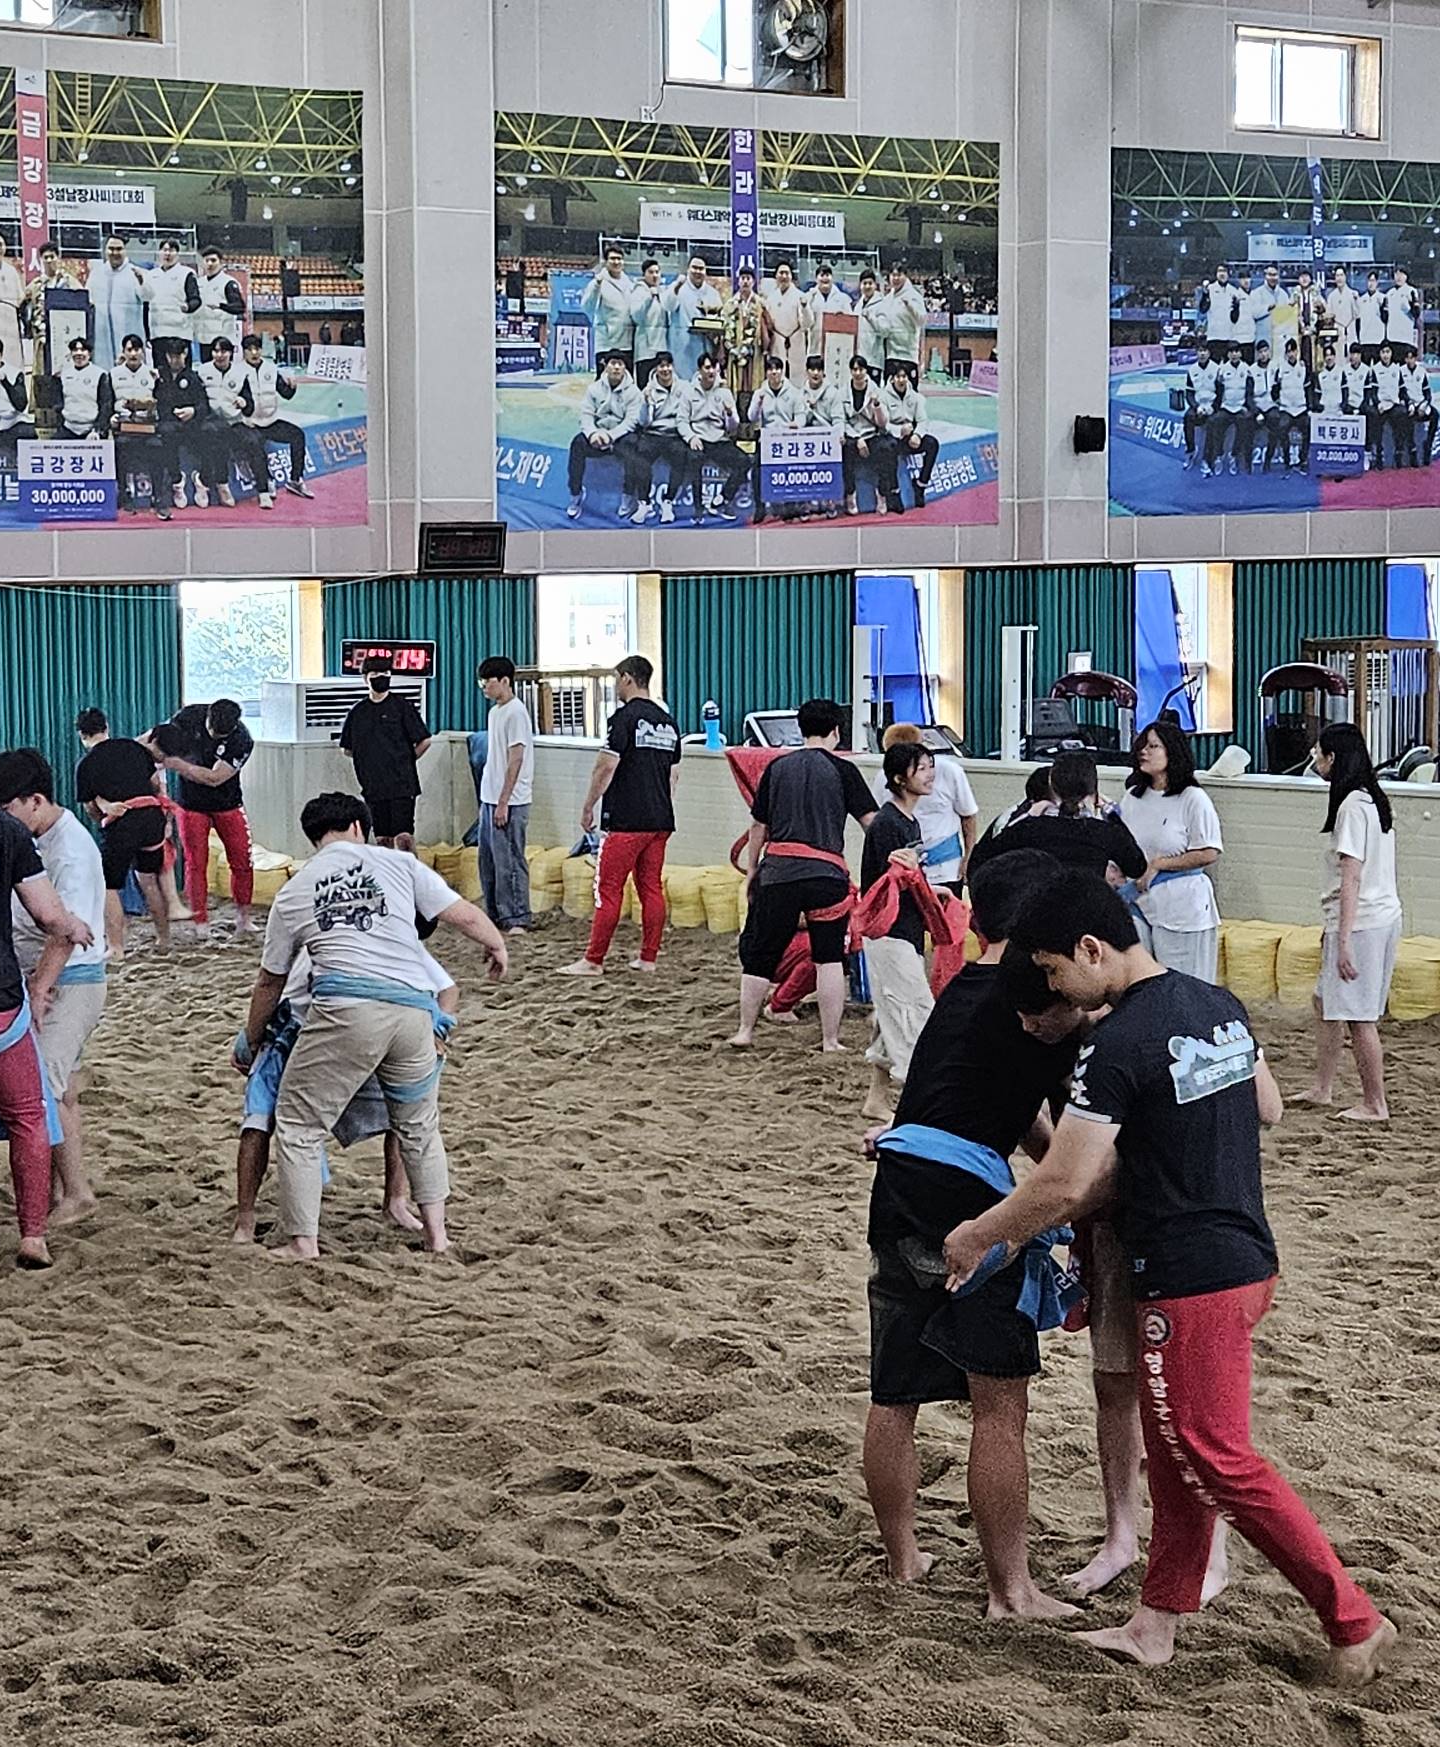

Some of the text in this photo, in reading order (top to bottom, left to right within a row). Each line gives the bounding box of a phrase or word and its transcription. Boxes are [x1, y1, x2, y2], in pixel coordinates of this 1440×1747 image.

[1143, 414, 1187, 449] 위더스제
[771, 441, 833, 459] 한라장사
[30, 456, 105, 474] 금강장사
[771, 470, 833, 487] 30,000,000
[31, 489, 106, 506] 30,000,000
